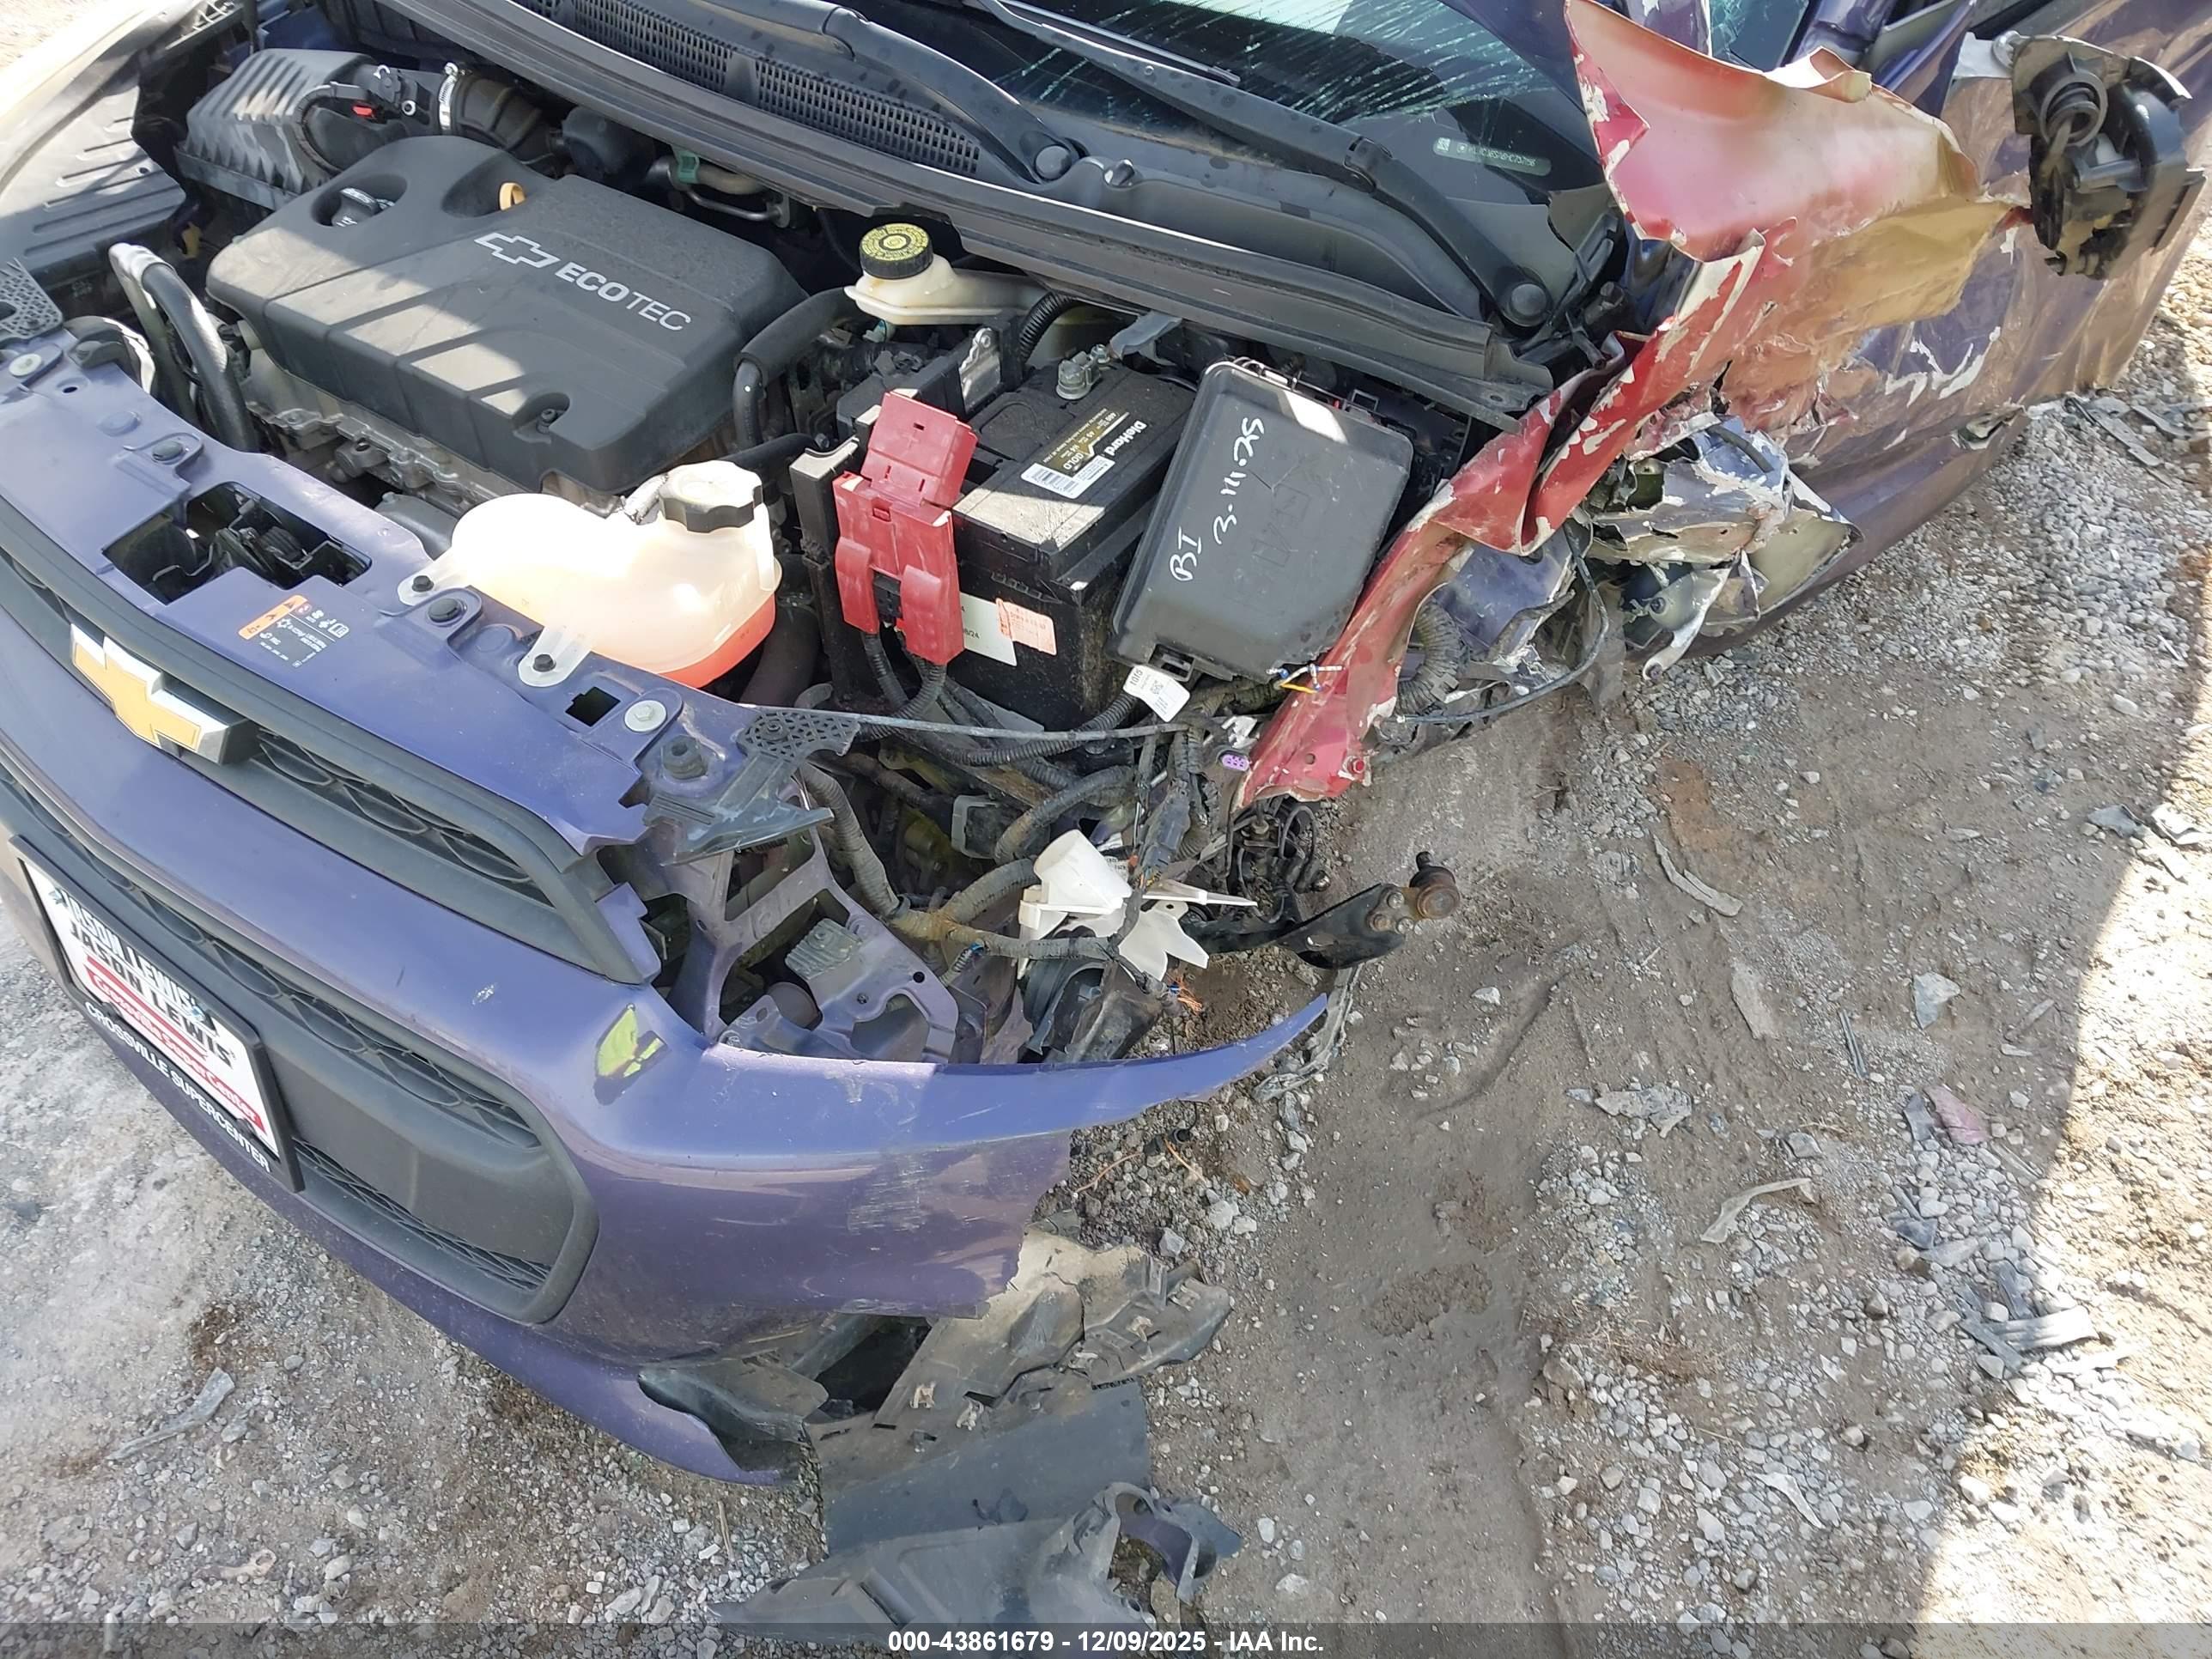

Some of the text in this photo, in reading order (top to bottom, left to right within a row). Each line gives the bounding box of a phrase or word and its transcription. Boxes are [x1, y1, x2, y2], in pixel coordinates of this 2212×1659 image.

[555, 261, 691, 331] ECOTEC
[70, 921, 143, 996] JASON
[85, 1002, 270, 1173] CROSSVILLE SUPERCENTER
